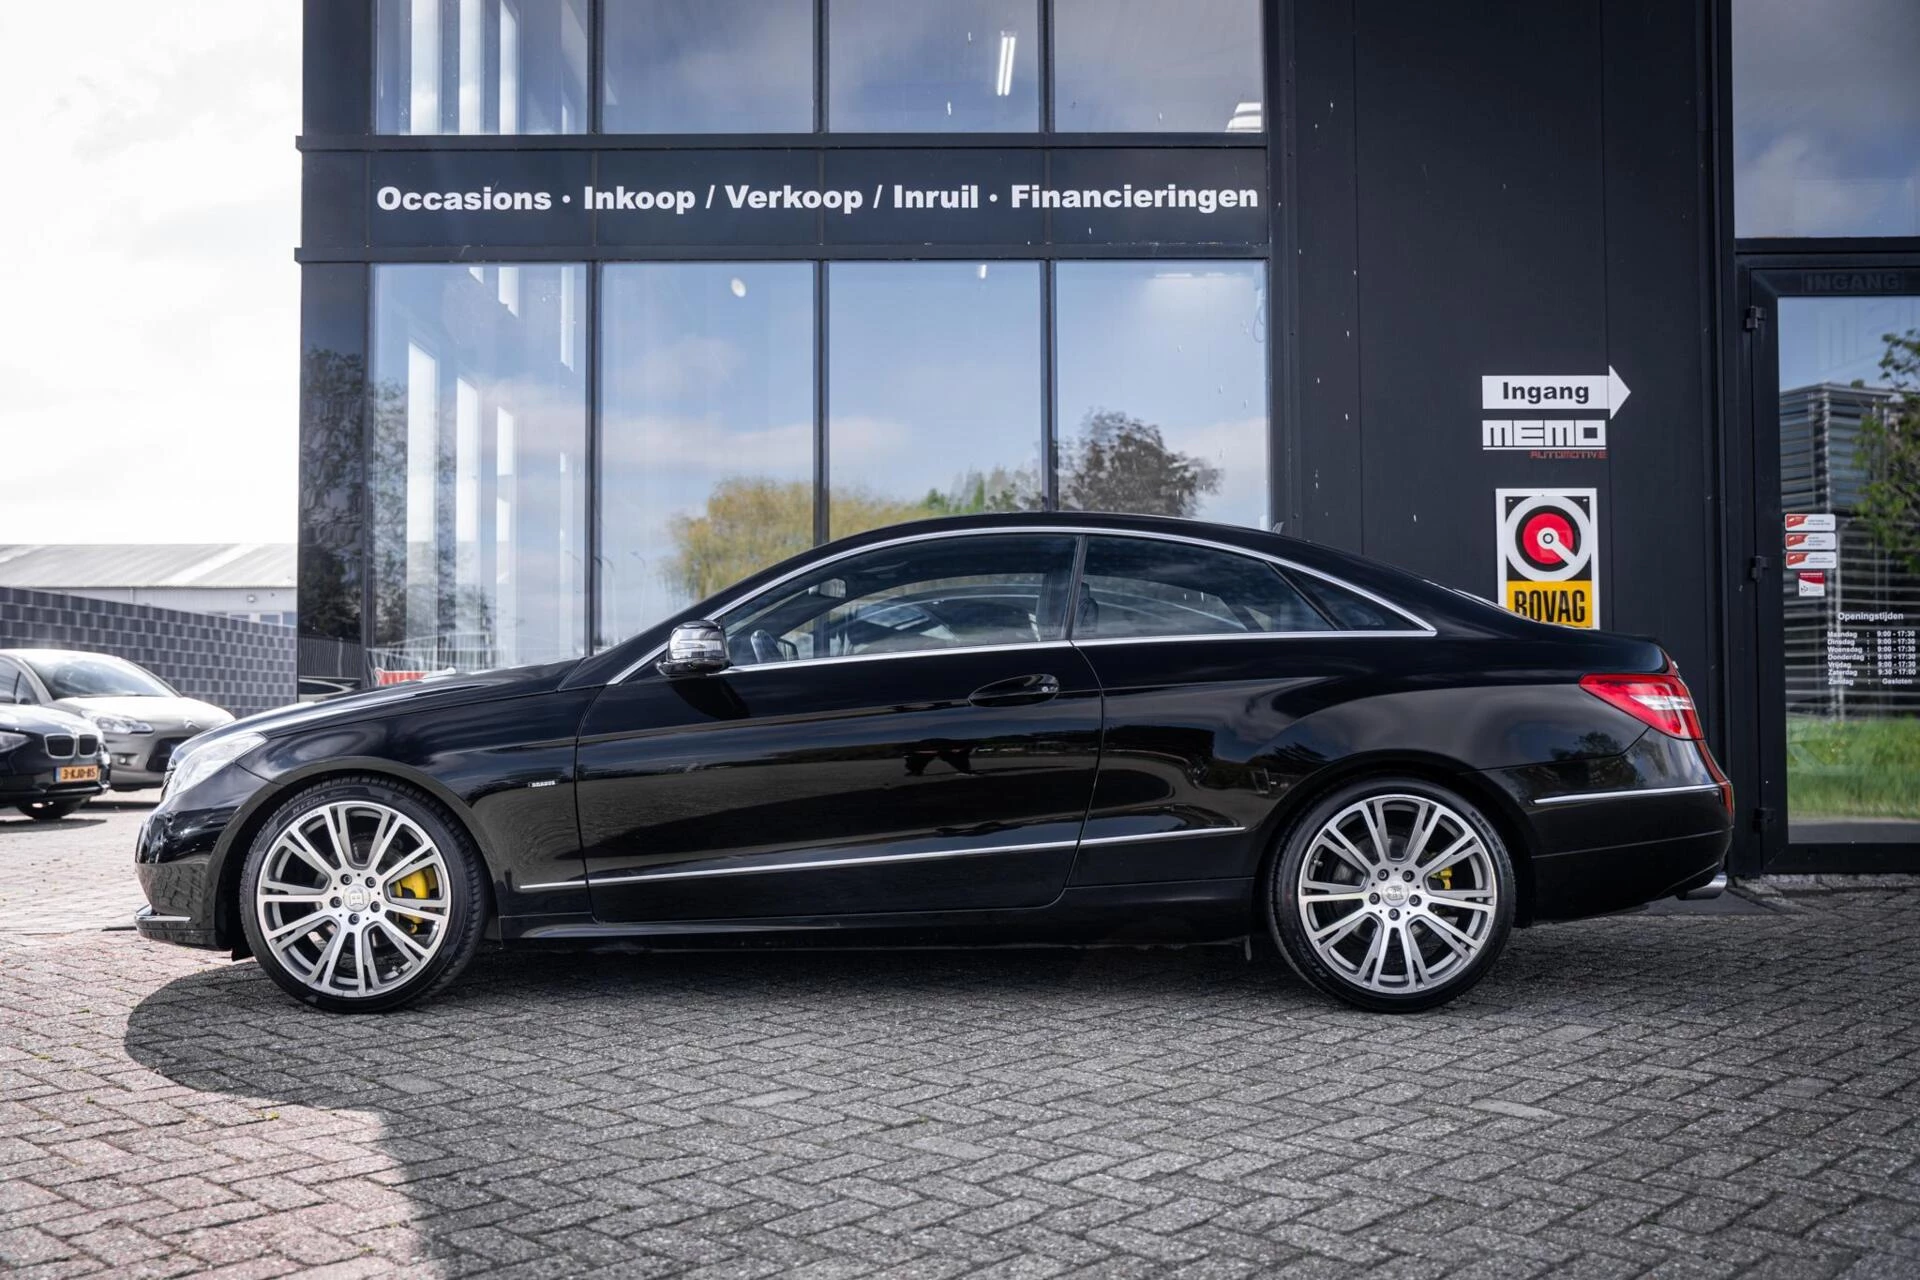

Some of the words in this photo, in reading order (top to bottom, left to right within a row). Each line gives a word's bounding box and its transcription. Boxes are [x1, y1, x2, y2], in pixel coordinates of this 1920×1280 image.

[377, 187, 552, 210] Occasions
[585, 186, 696, 214] Inkoop
[725, 185, 862, 214] Verkoop
[894, 185, 979, 208] Inruil
[1012, 184, 1258, 213] Financieringen
[1807, 272, 1899, 291] INGANG
[1503, 382, 1589, 404] Ingang
[1482, 420, 1606, 447] MEMO
[1530, 450, 1608, 459] AUTOMOTIVE
[1514, 590, 1585, 622] BOVAG
[1838, 612, 1904, 622] Openingstijden
